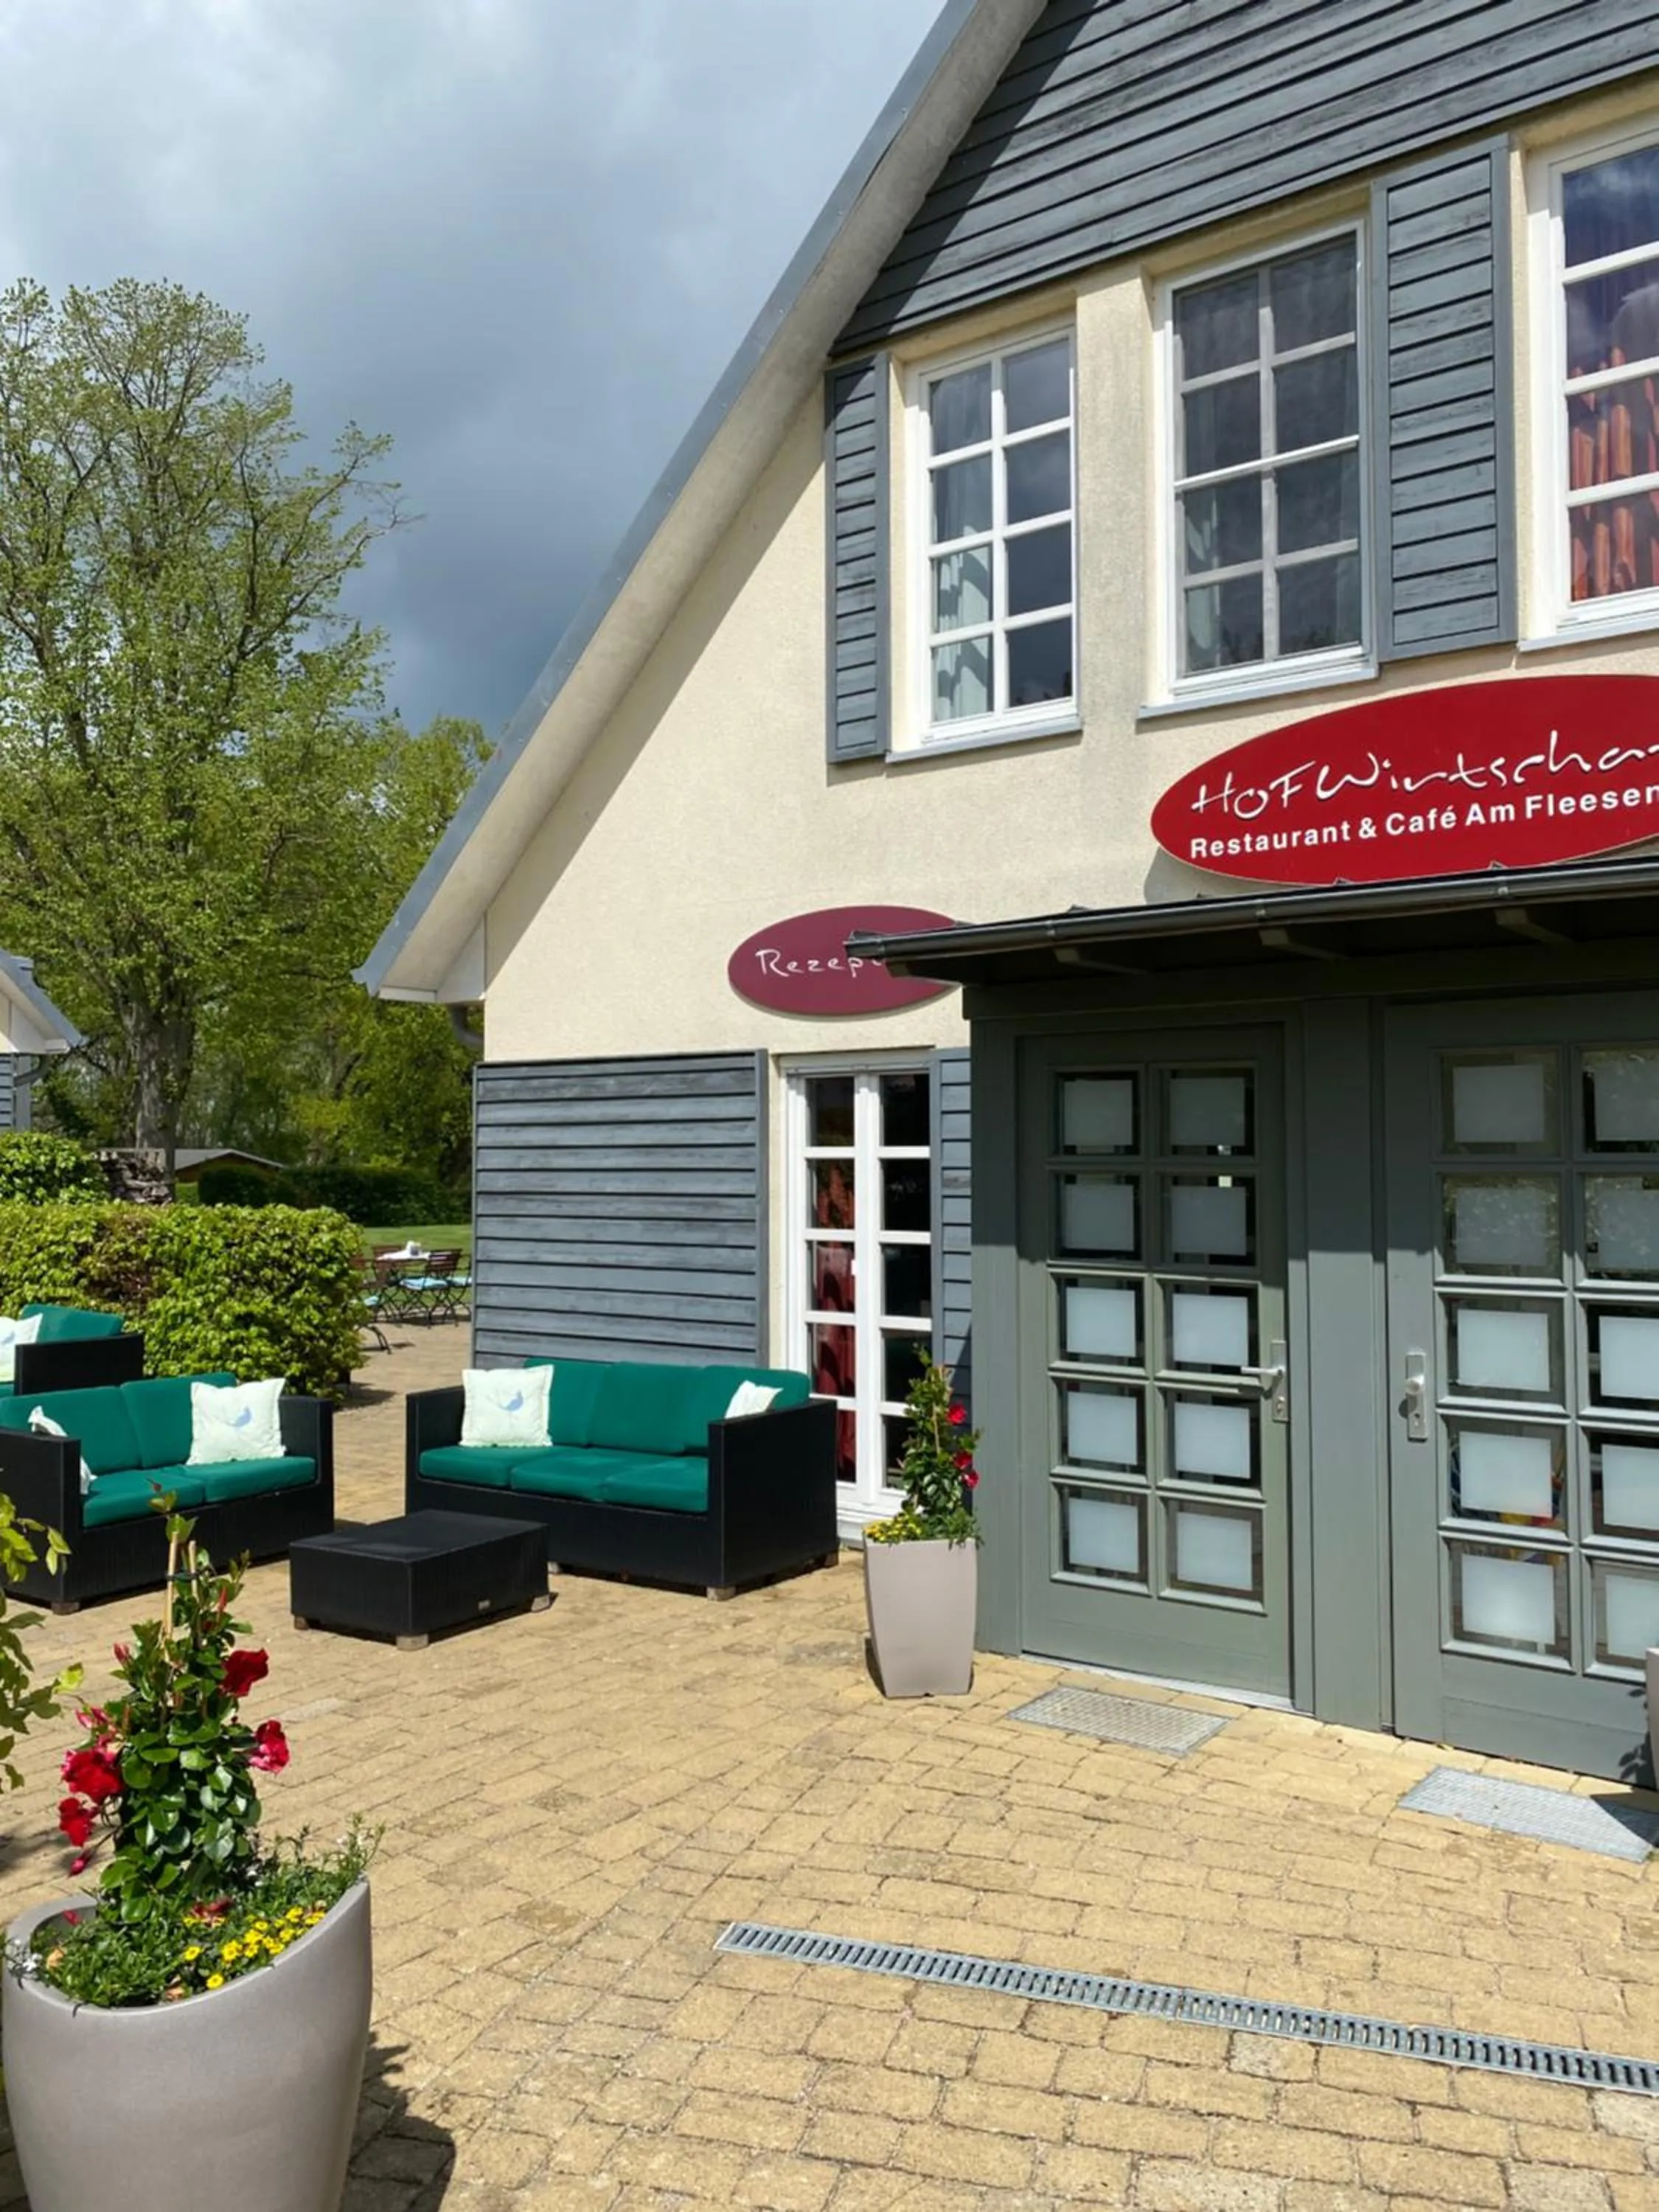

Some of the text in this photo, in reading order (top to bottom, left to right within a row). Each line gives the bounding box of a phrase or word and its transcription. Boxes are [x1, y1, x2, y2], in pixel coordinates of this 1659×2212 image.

[1190, 821, 1351, 859] Restaurant
[1358, 816, 1377, 839] &
[1385, 804, 1457, 835] Café
[1464, 802, 1515, 827] Am
[754, 948, 883, 978] Rezep
